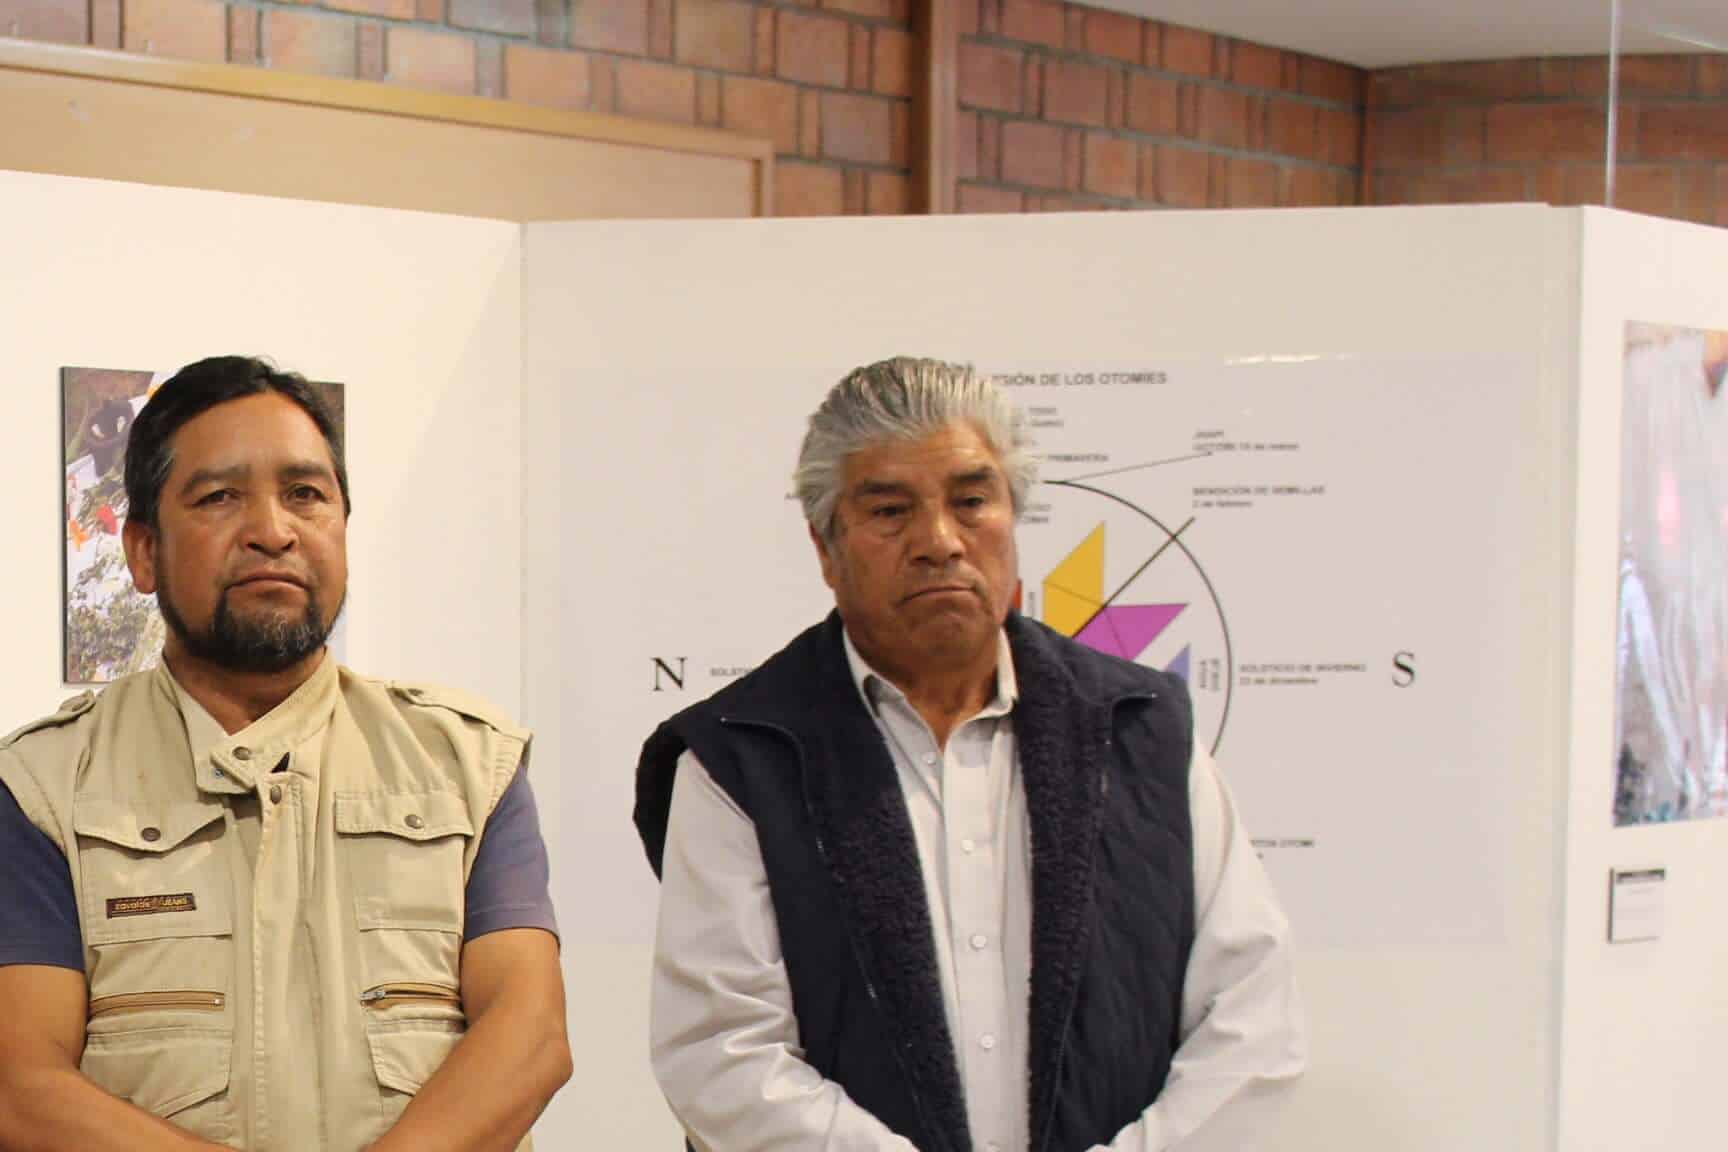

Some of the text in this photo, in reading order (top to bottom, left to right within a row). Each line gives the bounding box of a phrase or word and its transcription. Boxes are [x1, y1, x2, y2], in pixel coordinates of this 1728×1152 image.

[1039, 372, 1060, 387] DE
[1064, 372, 1095, 387] LOS
[649, 656, 688, 692] N
[1390, 649, 1417, 689] S
